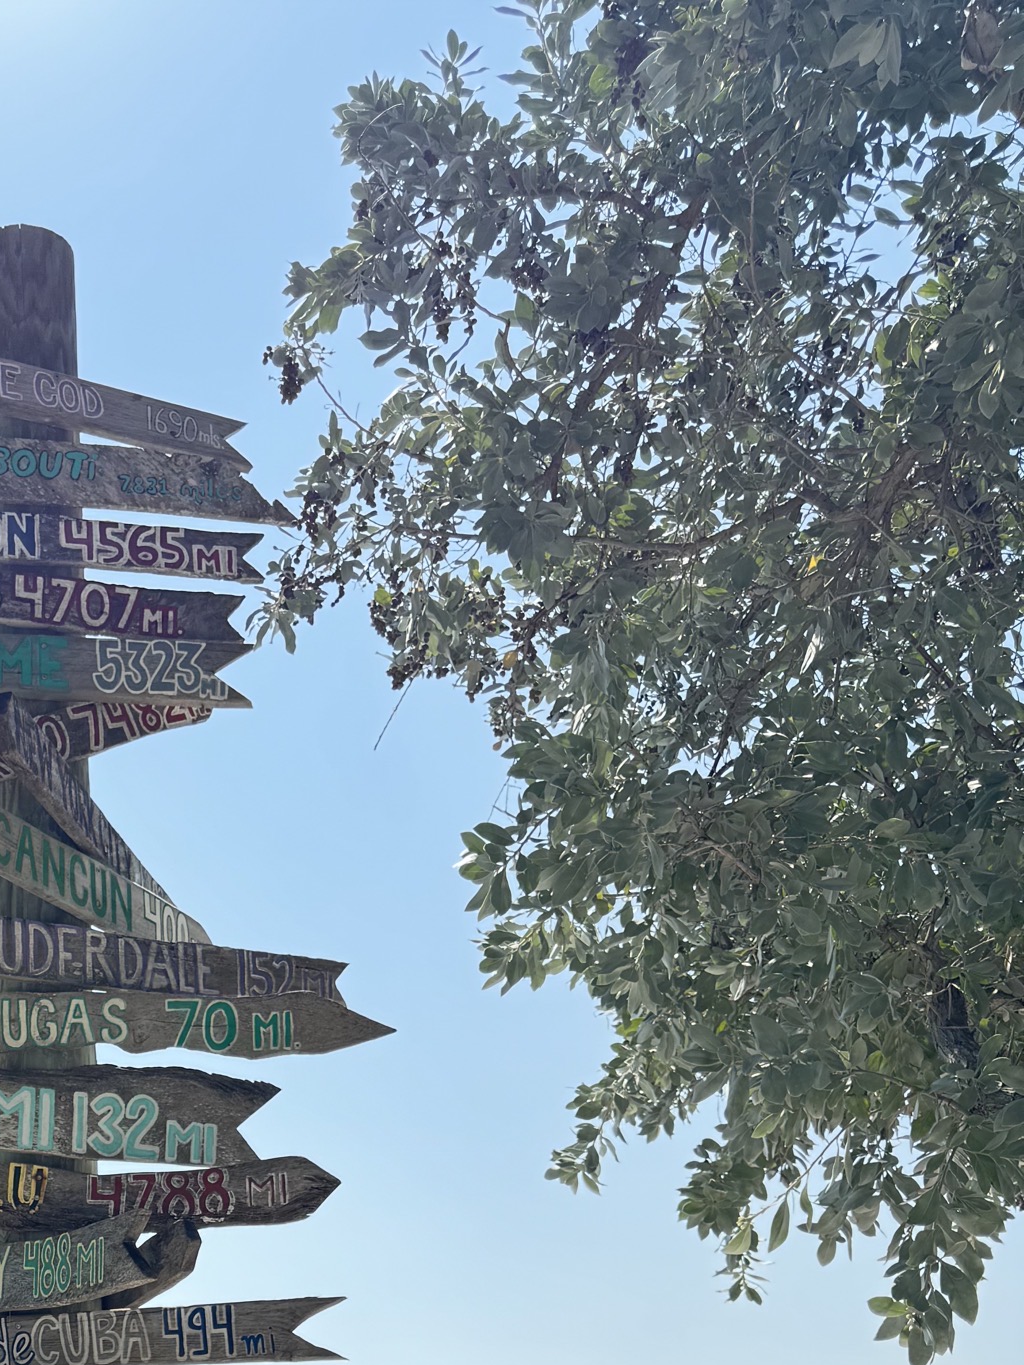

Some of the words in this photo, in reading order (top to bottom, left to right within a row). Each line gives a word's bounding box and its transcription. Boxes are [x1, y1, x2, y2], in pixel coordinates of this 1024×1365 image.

[33, 371, 104, 418] COD
[147, 405, 197, 442] 1690
[118, 474, 168, 496] 7831
[60, 518, 190, 569] 4565
[192, 543, 239, 576] MI
[15, 573, 138, 629] 4707
[92, 639, 206, 695] 5323
[200, 674, 228, 700] MI
[66, 702, 188, 751] 7482
[237, 950, 295, 997] 152
[301, 969, 334, 1000] MI
[164, 999, 238, 1052] 70
[72, 1091, 159, 1161] 132
[165, 1119, 217, 1166] MI
[86, 1167, 235, 1222] 4788
[246, 1172, 288, 1208] MI
[24, 1233, 71, 1298] 488
[76, 1237, 104, 1287] MI
[163, 1304, 236, 1361] 494
[240, 1327, 276, 1355] mi
